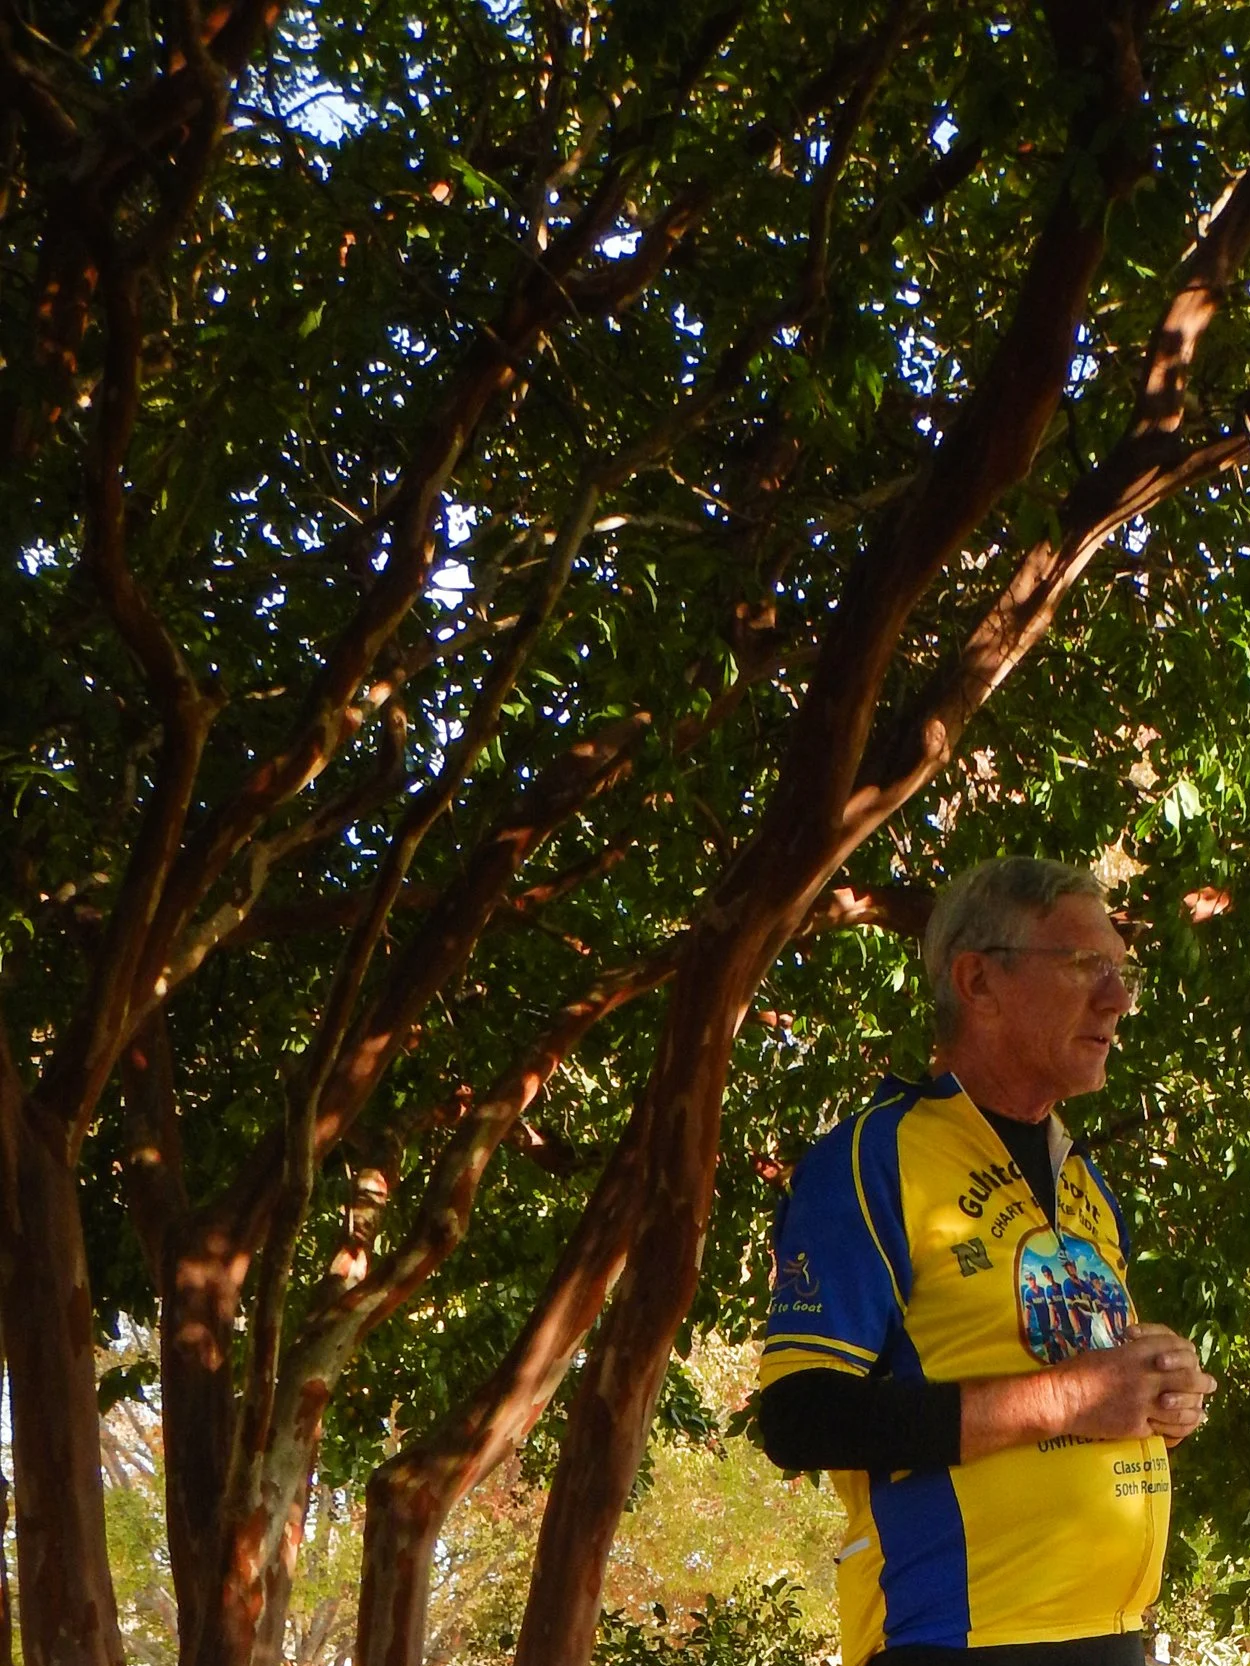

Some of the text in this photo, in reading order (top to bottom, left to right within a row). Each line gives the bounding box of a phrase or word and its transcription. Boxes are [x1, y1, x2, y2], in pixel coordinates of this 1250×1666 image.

[792, 1300, 823, 1313] Goat
[1113, 1460, 1140, 1475] Class
[1115, 1480, 1139, 1497] 50th
